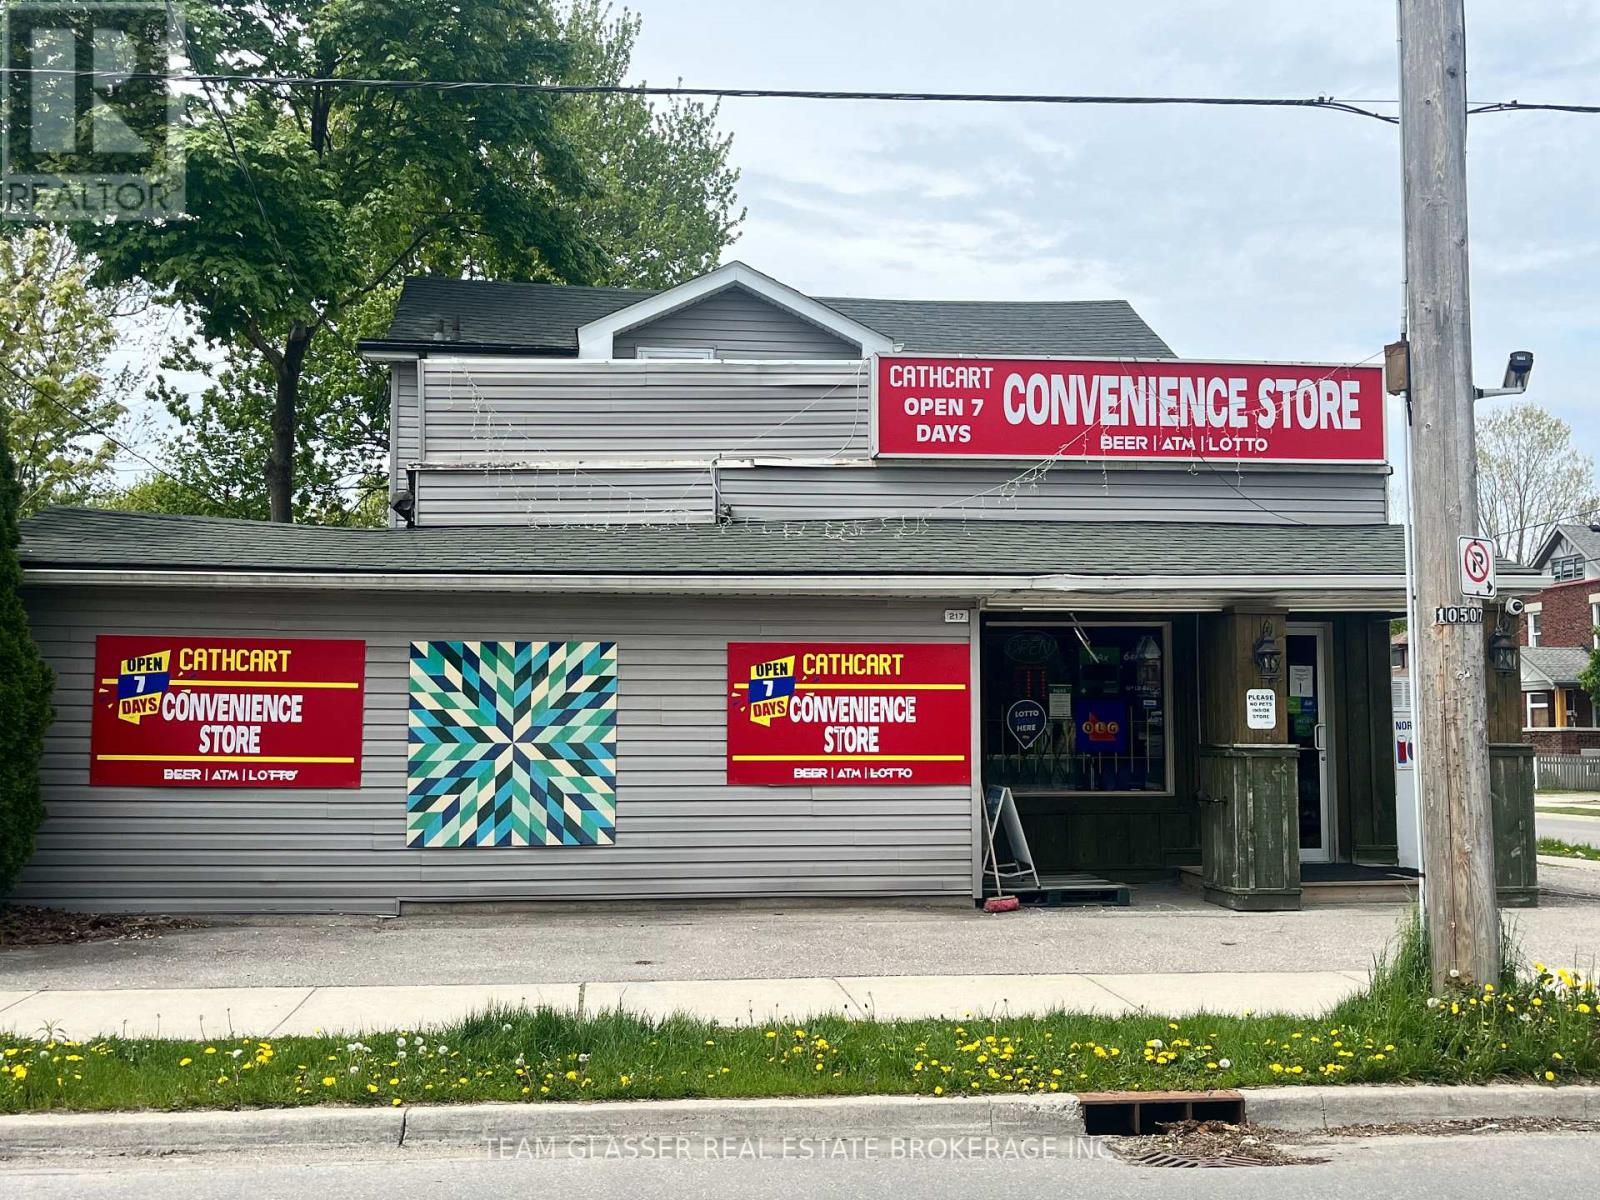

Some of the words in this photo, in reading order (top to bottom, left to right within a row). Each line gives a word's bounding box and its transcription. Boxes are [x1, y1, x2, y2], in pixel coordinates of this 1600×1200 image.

[889, 365, 994, 389] CATHCART
[904, 397, 963, 416] OPEN
[971, 399, 984, 416] 7
[1003, 373, 1248, 428] CONVENIENCE
[1257, 377, 1361, 430] STORE
[916, 424, 971, 443] DAYS
[1100, 435, 1148, 451] BEER
[1161, 436, 1196, 452] ATM
[1209, 437, 1268, 452] LOTTO
[948, 612, 964, 620] 217
[1437, 608, 1483, 623] 10507
[127, 657, 163, 672] OPEN
[179, 648, 291, 672] CATHCART
[803, 653, 904, 675] CATHCART
[755, 662, 788, 677] OPEN
[133, 676, 146, 693] 7
[762, 680, 774, 697] 7
[122, 697, 157, 715] DAYS
[162, 692, 303, 723] CONVENIENCE
[753, 700, 785, 717] DAYS
[789, 695, 917, 723] CONVENIENCE
[1015, 710, 1039, 718] LOTTO
[1082, 721, 1119, 734] OLG
[199, 725, 261, 754] STORE
[823, 726, 880, 753] STORE
[163, 769, 201, 781] BEER
[211, 769, 239, 781] ATM
[248, 769, 298, 781] LOTTO
[794, 768, 828, 779] BEER
[837, 768, 861, 778] ATM
[870, 768, 913, 778] LOTTO
